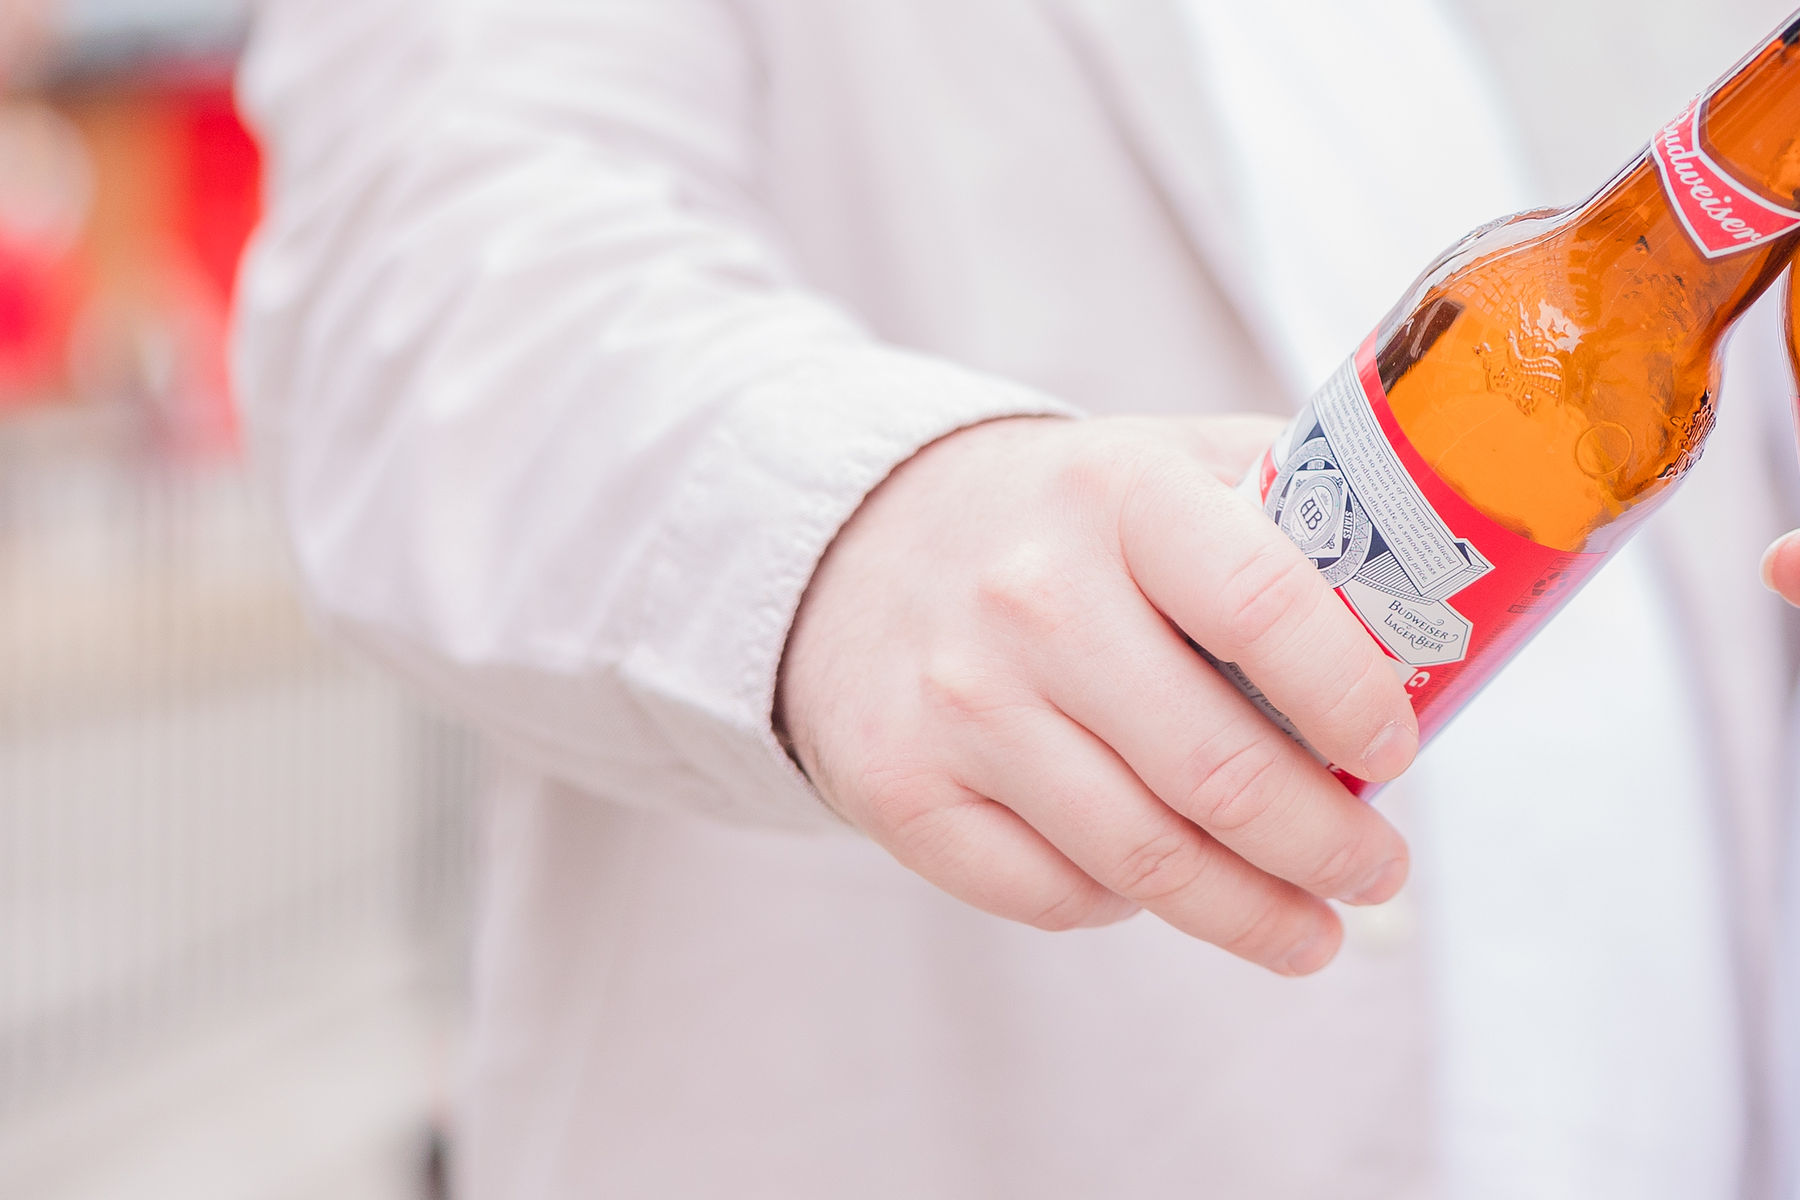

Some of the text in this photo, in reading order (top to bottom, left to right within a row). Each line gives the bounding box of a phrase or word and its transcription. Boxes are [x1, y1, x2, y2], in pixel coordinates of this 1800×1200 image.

[1300, 498, 1323, 530] AB
[1342, 510, 1353, 540] STATES
[1345, 456, 1359, 473] find
[1355, 473, 1364, 483] in
[1360, 483, 1370, 495] no
[1366, 494, 1386, 518] other
[1381, 517, 1398, 537] beer
[1394, 536, 1403, 545] at
[1400, 545, 1414, 562] any
[1354, 454, 1380, 492] produces
[1401, 530, 1436, 575] smoothness
[1355, 437, 1371, 458] costs
[1367, 458, 1376, 468] so
[1373, 467, 1391, 491] much
[1388, 491, 1397, 501] to
[1394, 501, 1412, 523] brew
[1408, 521, 1423, 539] and
[1431, 555, 1446, 570] Our
[1374, 450, 1385, 464] We
[1381, 463, 1398, 485] know
[1394, 485, 1405, 496] of
[1402, 494, 1413, 507] no
[1410, 506, 1430, 531] brand
[1426, 531, 1456, 565] produced
[1384, 613, 1421, 648] LAGER
[1415, 635, 1444, 652] BEER
[1388, 599, 1450, 640] BUDWEISER
